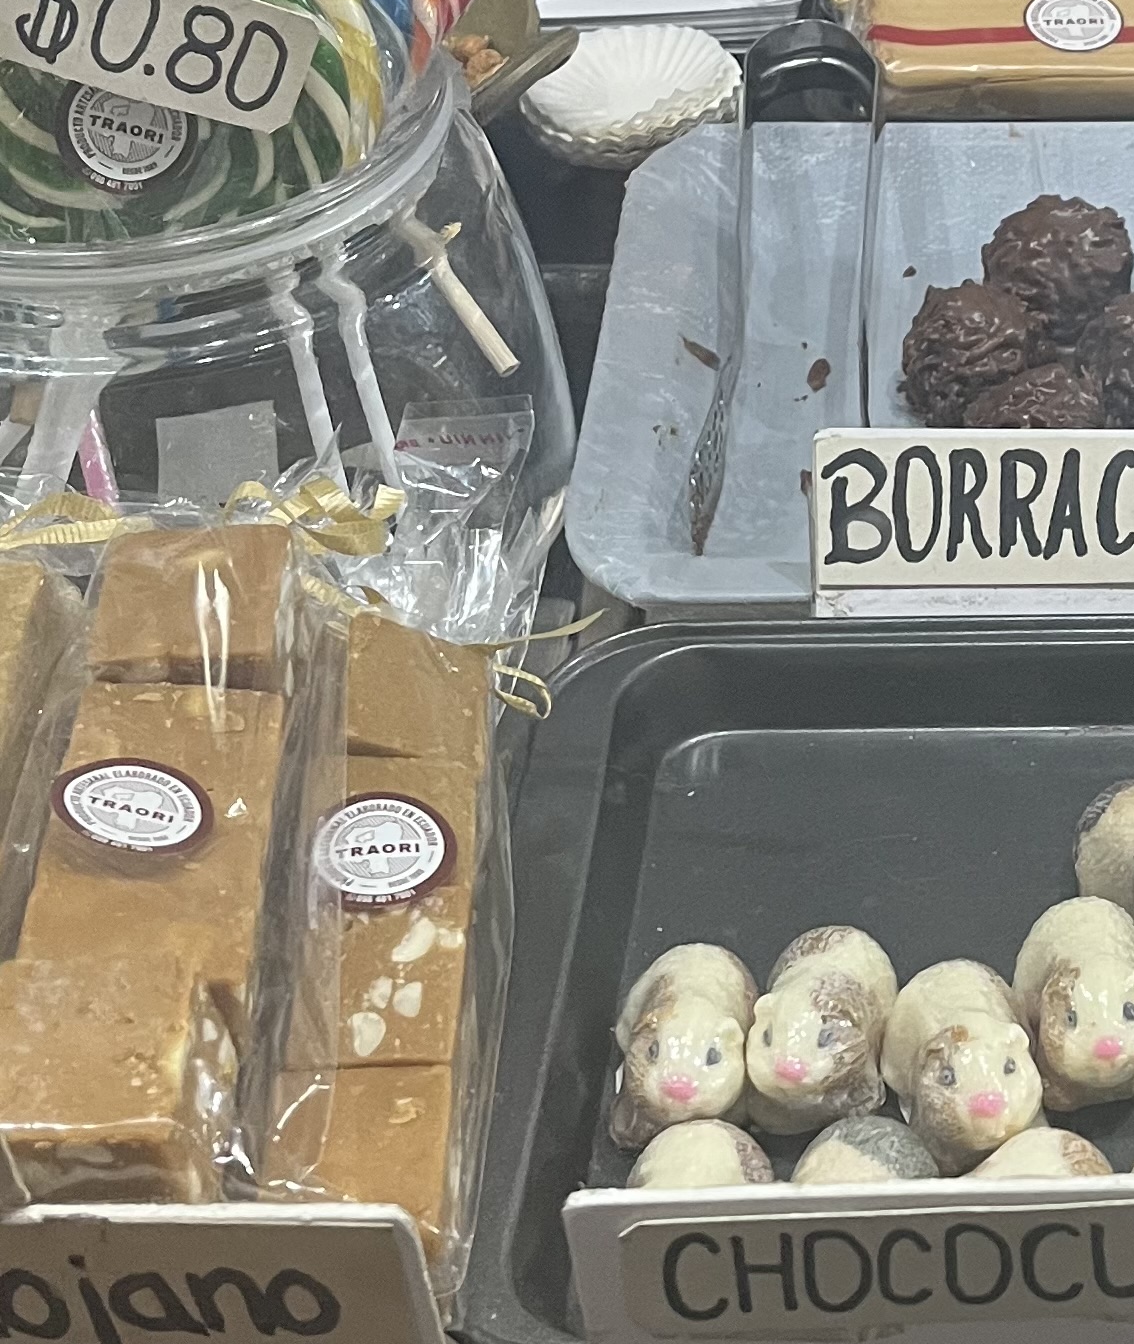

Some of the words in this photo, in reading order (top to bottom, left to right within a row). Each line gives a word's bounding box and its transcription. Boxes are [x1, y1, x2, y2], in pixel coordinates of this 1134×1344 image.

[1043, 18, 1105, 26] TRAORI
[89, 114, 164, 145] TRAORI
[88, 795, 174, 824] TRAORI
[335, 843, 420, 859] TRAORI
